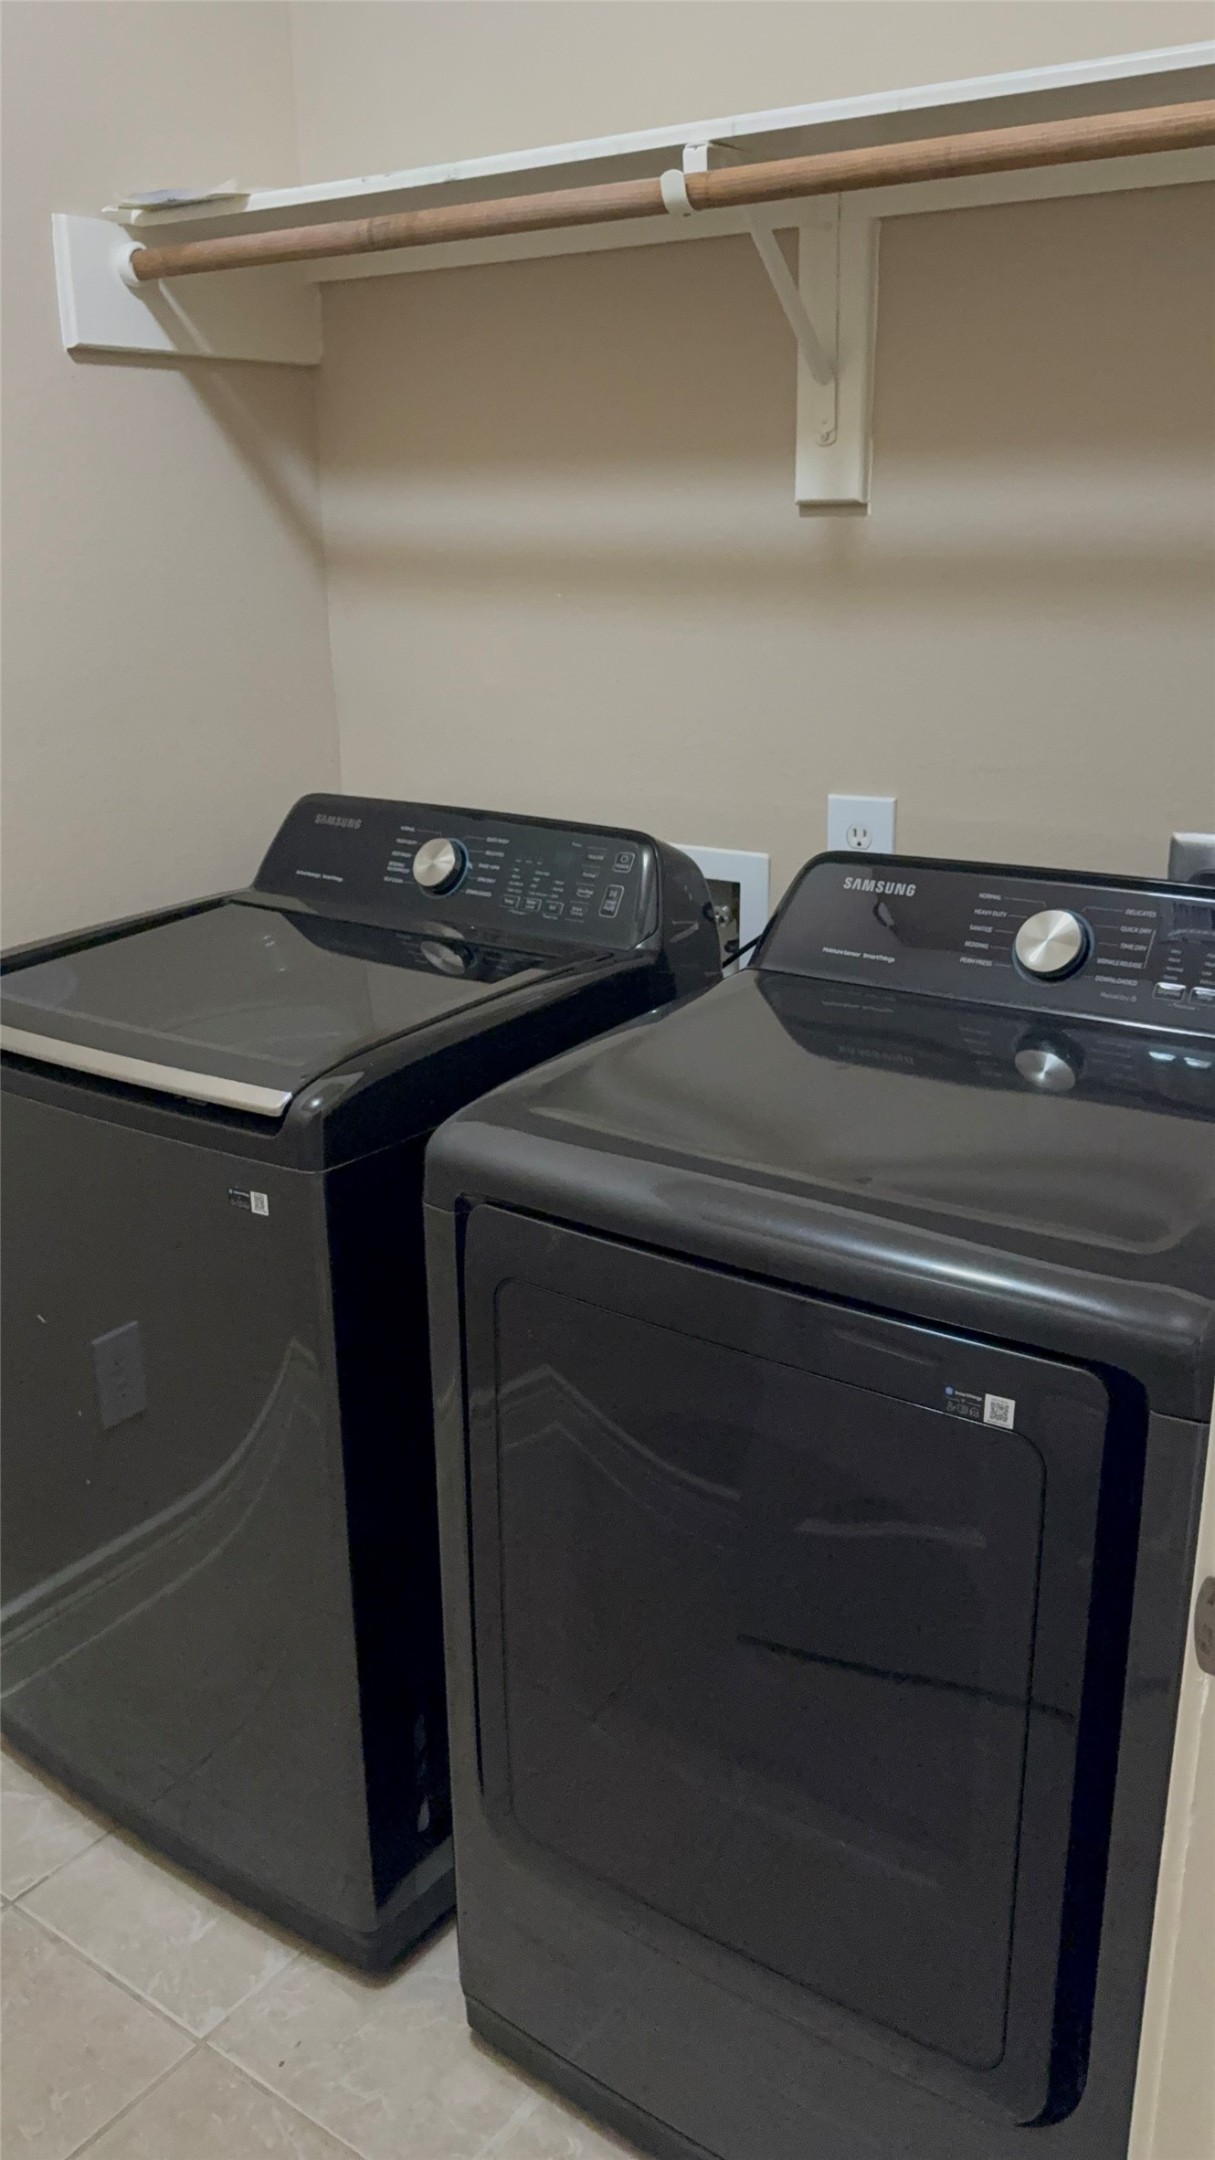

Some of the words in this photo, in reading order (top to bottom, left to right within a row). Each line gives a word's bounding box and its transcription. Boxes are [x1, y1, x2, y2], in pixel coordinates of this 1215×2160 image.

[314, 813, 362, 829] SAMSUNG
[843, 877, 916, 896] SAMSUNG
[974, 908, 993, 917] HEAVY
[992, 910, 1008, 918] DUTY
[1125, 908, 1156, 918] DELICATES
[1120, 925, 1139, 933] QUICK
